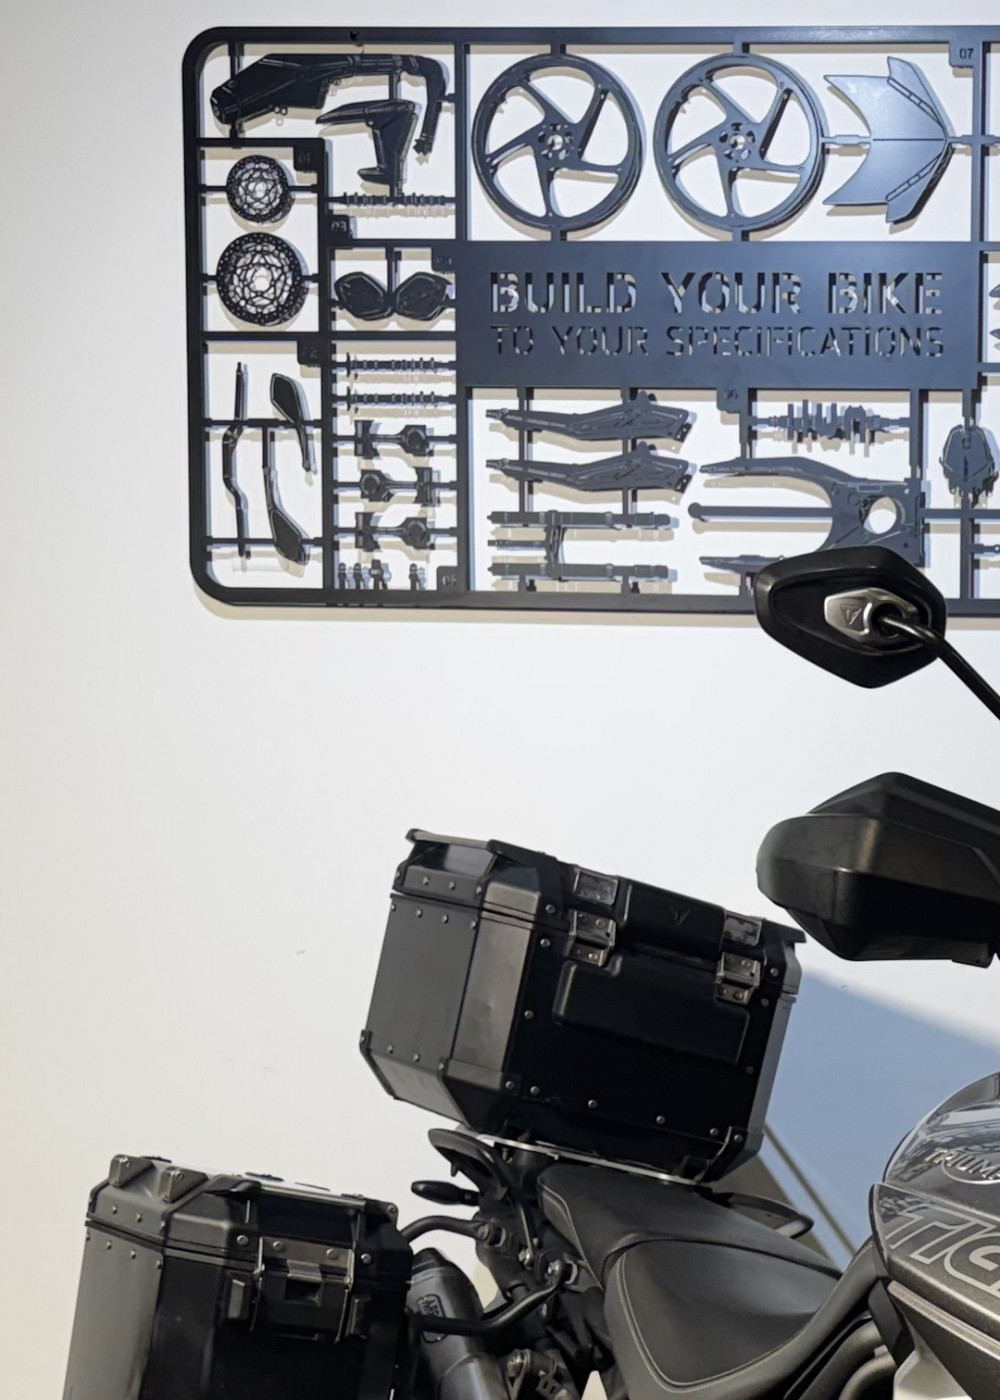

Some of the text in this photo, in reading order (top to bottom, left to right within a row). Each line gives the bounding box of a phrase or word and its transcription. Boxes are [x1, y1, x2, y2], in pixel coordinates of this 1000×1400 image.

[959, 47, 975, 61] 07
[490, 271, 943, 314] BUILD YOUR BIKE
[490, 325, 944, 357] TO YOUR SPECIFICATIONS
